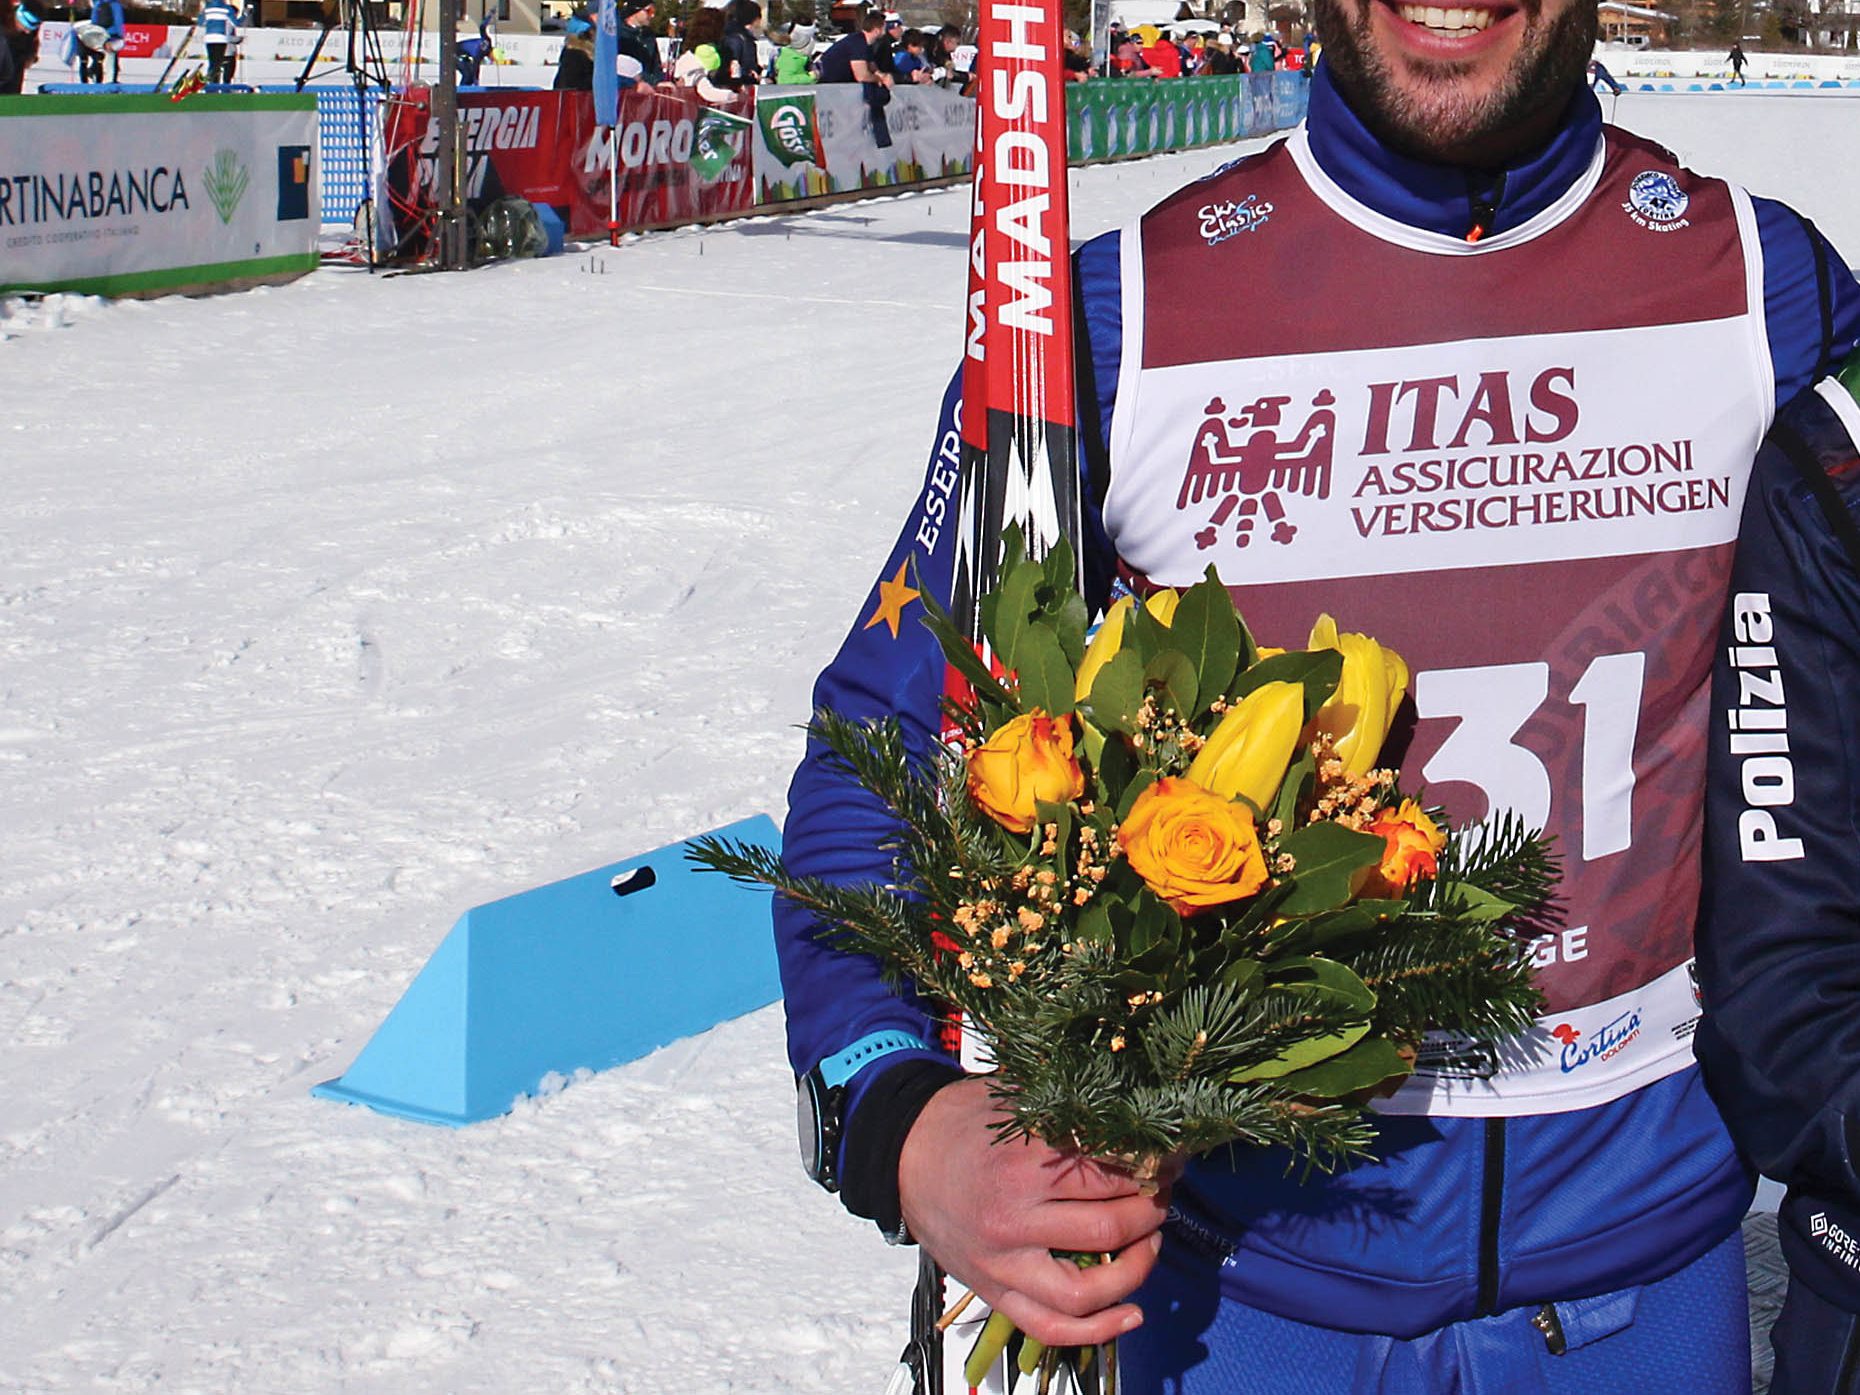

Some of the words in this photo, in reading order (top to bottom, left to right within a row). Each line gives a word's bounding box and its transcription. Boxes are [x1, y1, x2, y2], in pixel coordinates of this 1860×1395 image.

[1647, 218, 1691, 233] Skating
[1357, 366, 1581, 456] ITAS
[1352, 439, 1695, 498] ASSICURAZIONI
[1349, 476, 1731, 539] VERSICHERUNGEN
[1412, 651, 1645, 862] 31
[1728, 592, 1806, 862] Polizia
